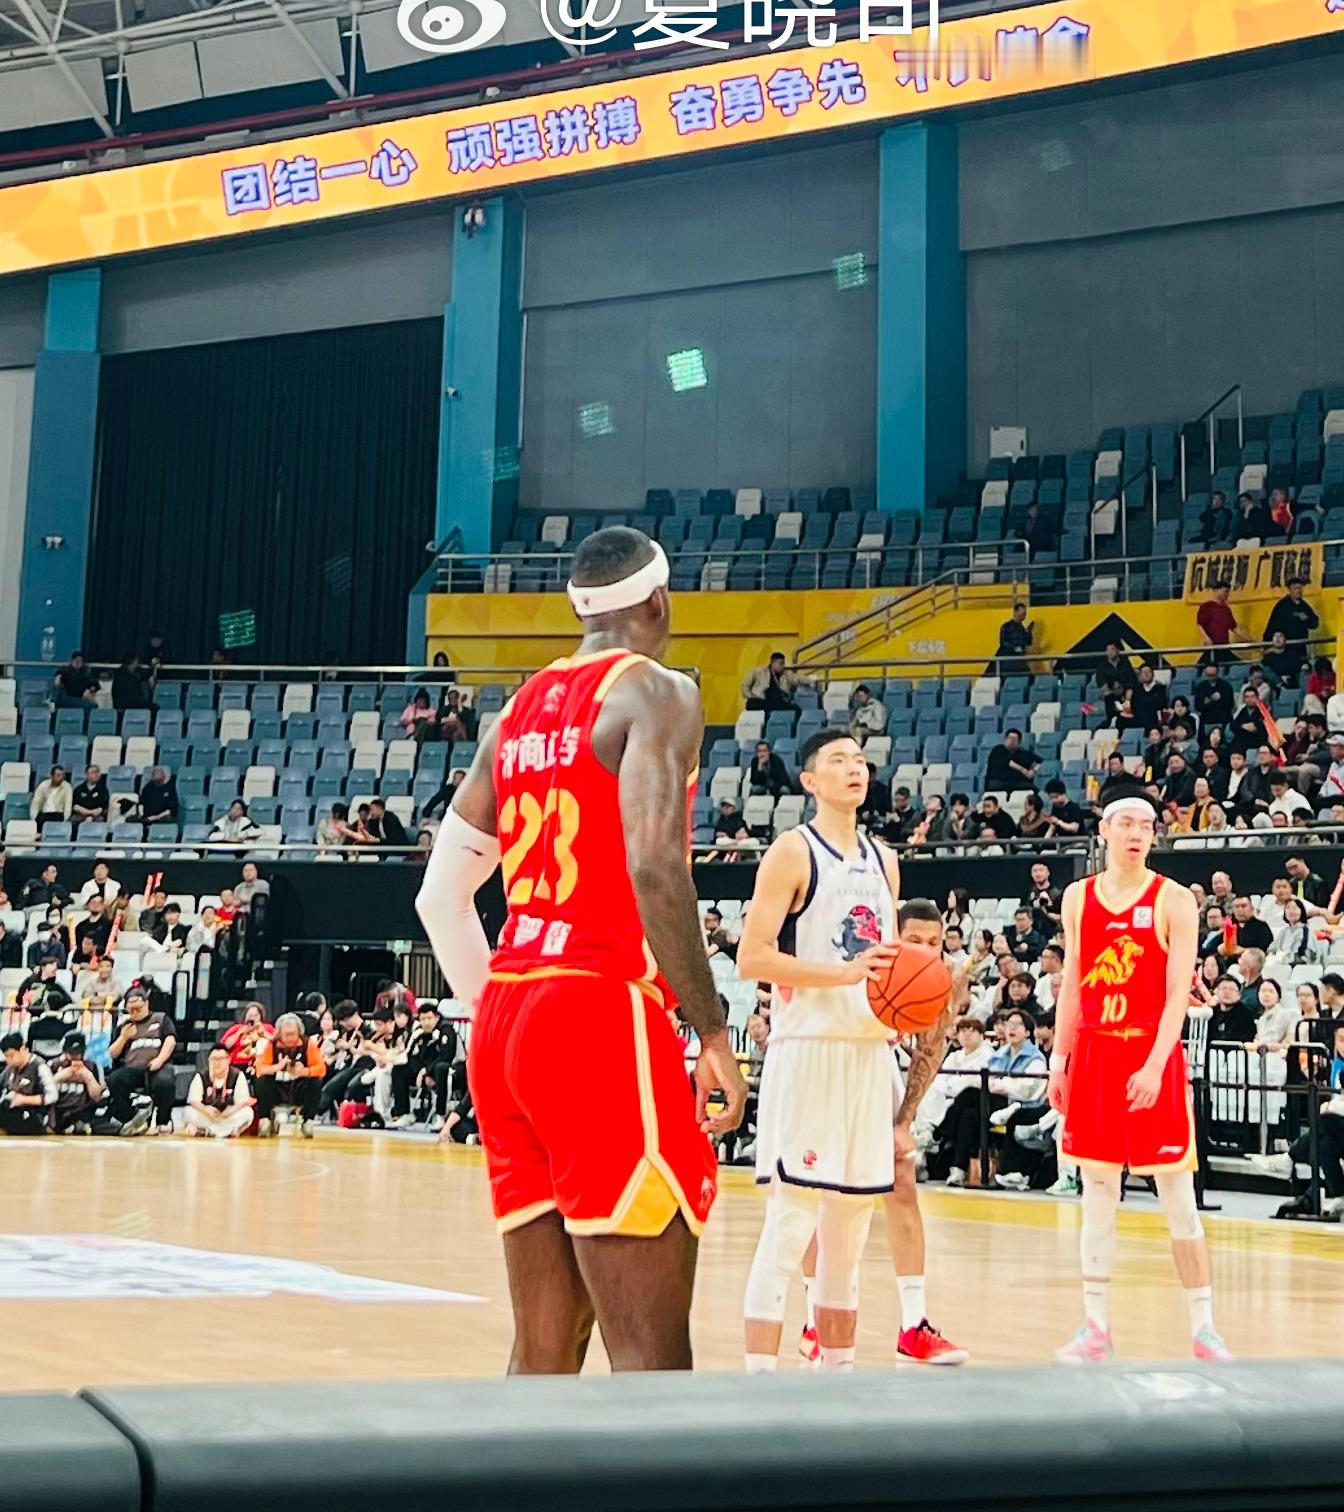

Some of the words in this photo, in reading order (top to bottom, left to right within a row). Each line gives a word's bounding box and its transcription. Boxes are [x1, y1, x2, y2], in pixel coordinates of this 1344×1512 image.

[222, 138, 418, 216] 团结一心
[447, 95, 641, 175] 顽强拼搏
[670, 59, 866, 136] 奋勇争先
[500, 788, 580, 906] 23
[1100, 993, 1128, 1024] 10
